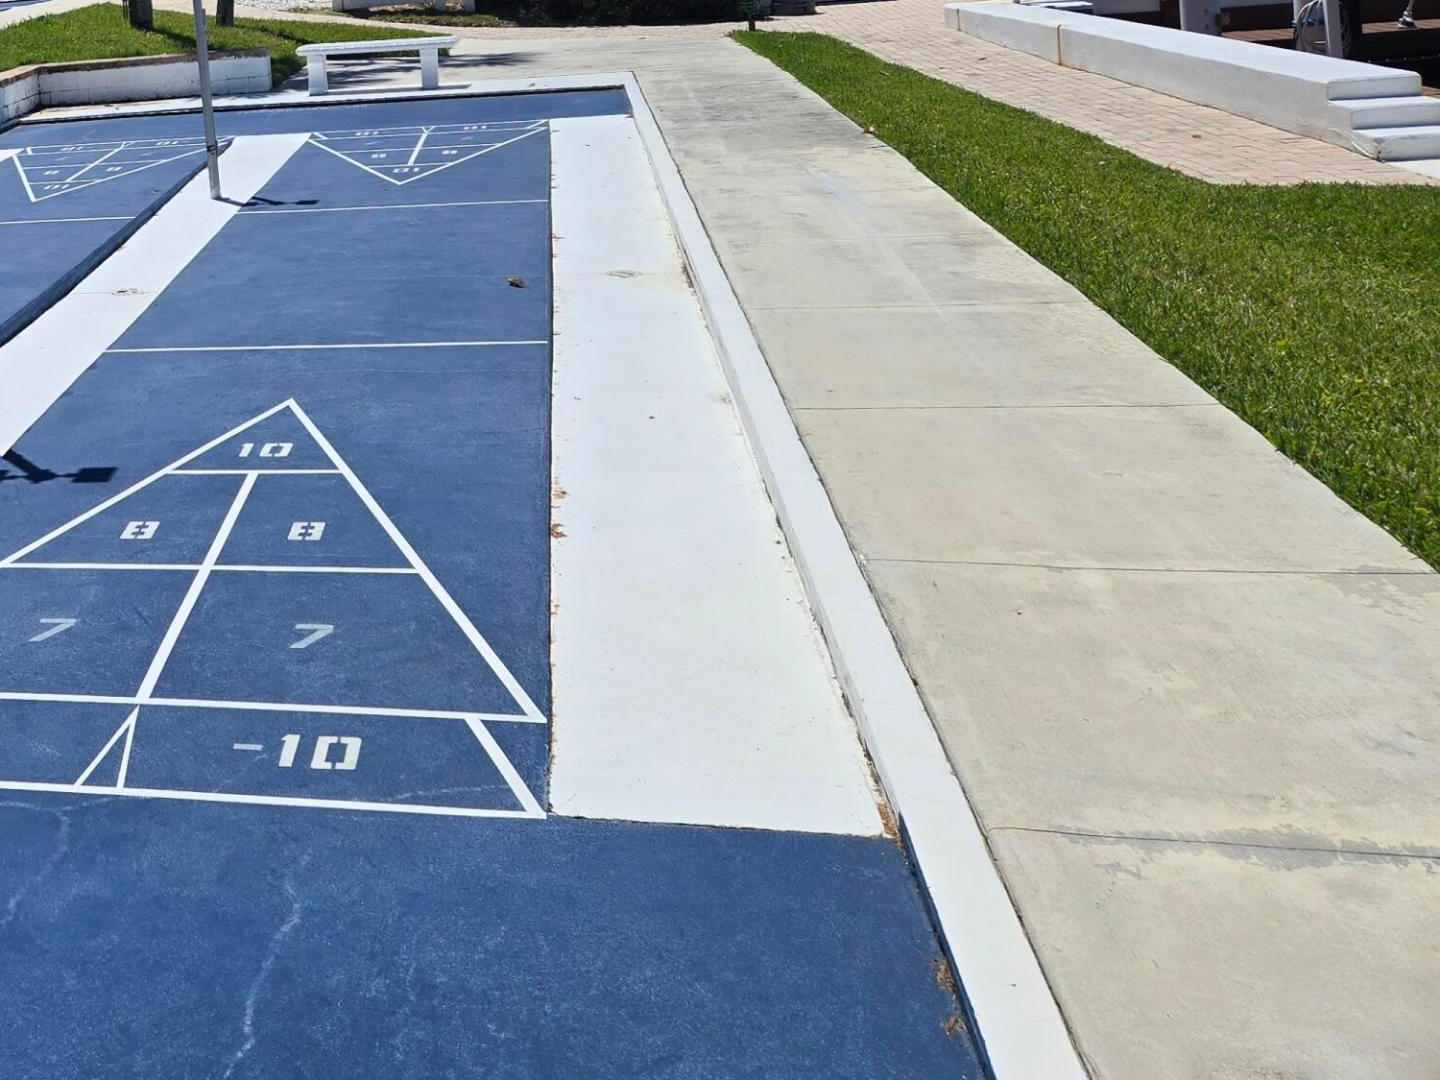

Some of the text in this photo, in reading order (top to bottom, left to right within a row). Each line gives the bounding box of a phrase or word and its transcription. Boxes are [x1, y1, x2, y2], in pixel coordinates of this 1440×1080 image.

[238, 442, 294, 458] 10
[119, 520, 160, 540] 8
[287, 521, 326, 541] 8
[28, 617, 81, 642] 7
[289, 623, 335, 649] 7
[233, 733, 362, 770] -10
